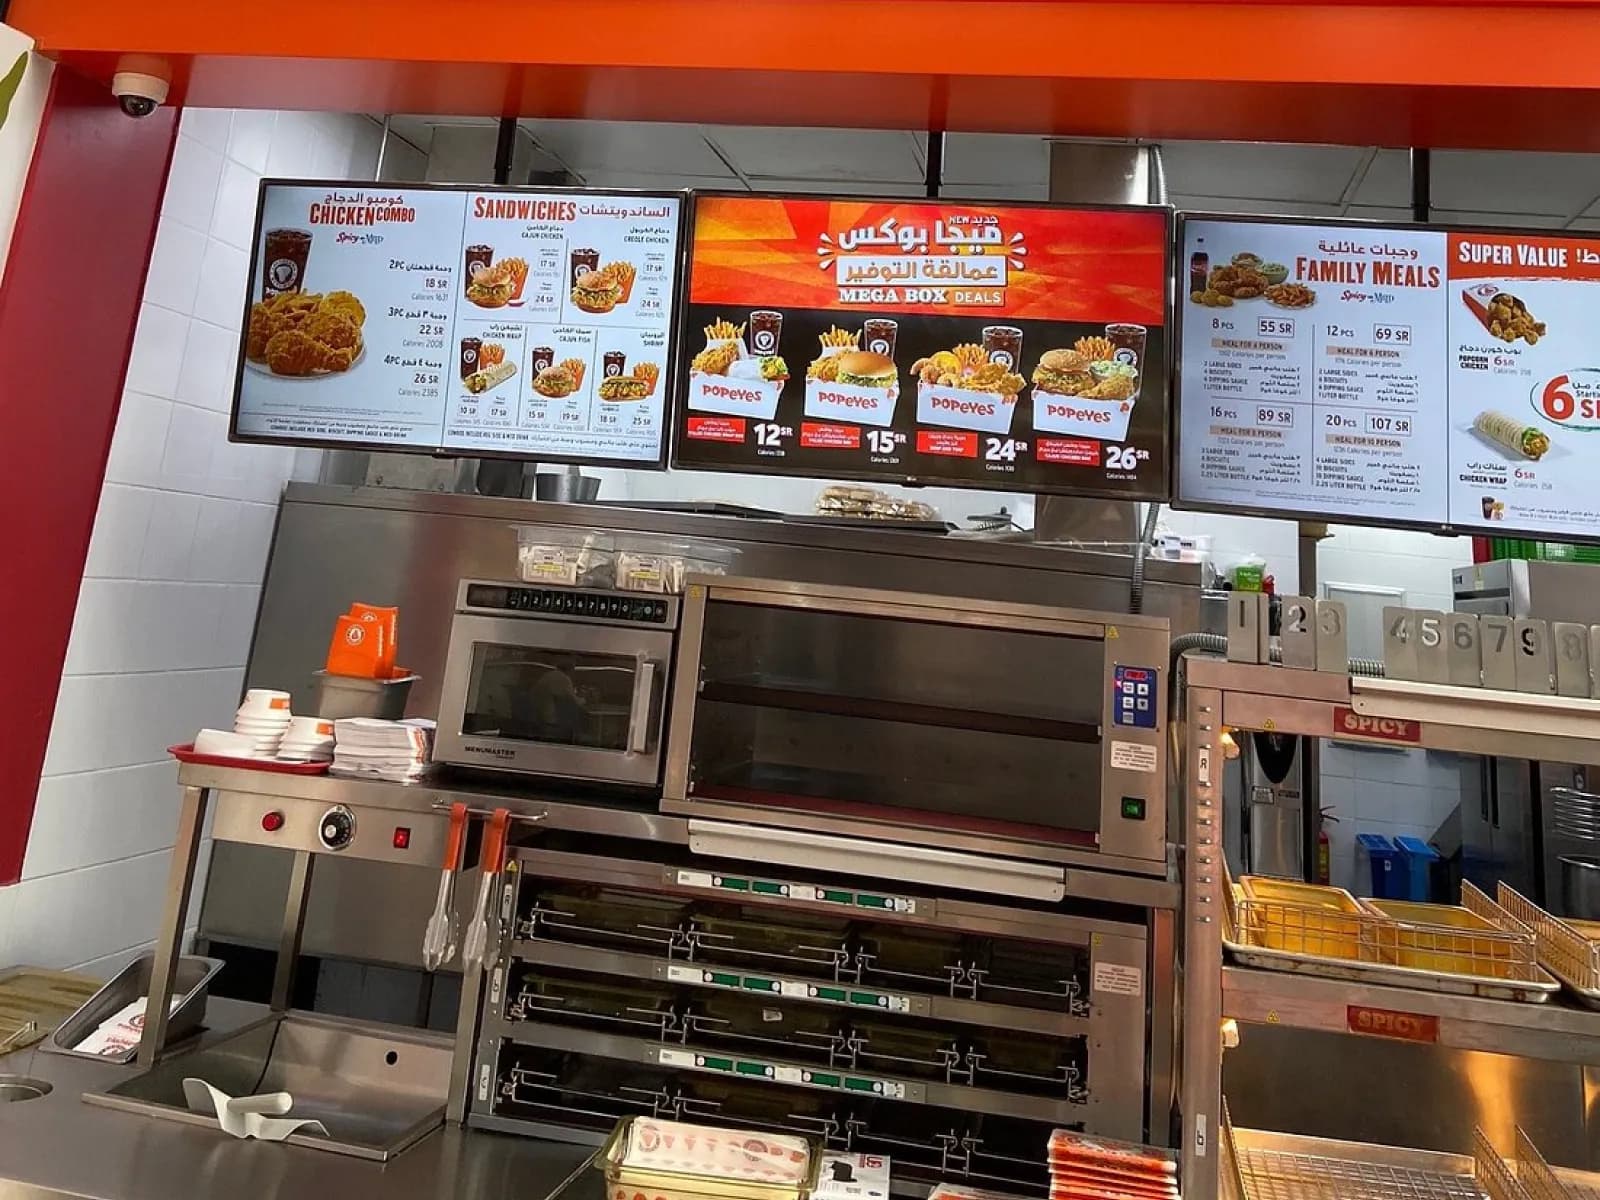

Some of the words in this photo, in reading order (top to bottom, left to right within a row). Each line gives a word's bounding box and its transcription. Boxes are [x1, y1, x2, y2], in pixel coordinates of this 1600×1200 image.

[325, 191, 363, 204] الدجاج
[366, 194, 404, 206] كومبو
[309, 203, 375, 226] CHICKEN
[376, 206, 415, 222] COMBO
[474, 196, 577, 222] SANDWICHES
[579, 203, 671, 219] الساندويتشات
[949, 215, 970, 225] NEW
[970, 215, 998, 227] جديد
[335, 231, 359, 244] Spicy
[624, 235, 644, 243] CREOLE
[646, 236, 670, 244] CHICKEN
[837, 217, 929, 255] بوكس
[1318, 240, 1366, 255] عائلية
[1369, 242, 1418, 260] وجبات
[1459, 241, 1512, 265] SUPER
[1516, 244, 1569, 268] VALUE
[389, 259, 405, 270] 2PC
[540, 260, 548, 268] 17
[646, 264, 653, 272] 17
[654, 264, 663, 272] SR
[921, 259, 998, 280] عمالقة
[845, 261, 917, 282] التوفير
[1296, 256, 1367, 285] FAMILY
[1372, 260, 1441, 288] MEALS
[425, 278, 436, 288] 18
[437, 280, 448, 289] SR
[535, 295, 545, 303] 24
[545, 296, 554, 304] SR
[839, 288, 899, 303] MEGA
[905, 289, 948, 303] BOX
[955, 291, 1002, 304] DEALS
[1341, 289, 1367, 302] Spicy
[641, 299, 651, 308] 24
[388, 307, 404, 317] 3PC
[419, 325, 432, 335] 22
[433, 326, 445, 335] SR
[1212, 318, 1220, 329] 8
[1221, 322, 1234, 330] PCS
[1260, 320, 1276, 333] 55
[1279, 322, 1292, 334] SR
[1327, 325, 1339, 336] 12
[1340, 329, 1354, 337] PCS
[1375, 328, 1392, 340] 69
[1395, 330, 1409, 341] SR
[402, 339, 424, 348] Calories
[1337, 346, 1354, 355] MEAL
[1354, 347, 1367, 355] FOR
[1375, 349, 1400, 358] PERSON
[1458, 354, 1489, 363] POPCORN
[384, 354, 401, 365] 4PC
[1493, 355, 1502, 366] 6
[1502, 358, 1515, 367] SR
[1323, 368, 1341, 376] LARGE
[1459, 362, 1489, 371] CHICKEN
[414, 374, 426, 384] 26
[428, 374, 439, 384] SR
[398, 387, 420, 396] Calories
[1543, 374, 1575, 420] 6
[490, 408, 498, 416] 17
[528, 411, 535, 419] 15
[537, 411, 545, 419] SR
[1210, 405, 1222, 417] 16
[1224, 410, 1237, 419] PCS
[1581, 398, 1600, 419] S
[1258, 408, 1275, 422] 89
[1278, 412, 1291, 424] SR
[1326, 414, 1341, 426] 20
[1343, 419, 1357, 428] PCS
[1371, 417, 1391, 431] 107
[1395, 420, 1409, 432] SR
[754, 423, 780, 446] 12
[780, 427, 793, 437] SR
[866, 430, 894, 454] 15
[894, 433, 907, 444] SR
[1335, 436, 1352, 444] MEAL
[1353, 437, 1366, 445] FOR
[1375, 438, 1402, 448] PERSON
[985, 437, 1015, 462] 24
[1015, 441, 1028, 452] SR
[1106, 446, 1137, 470] 26
[1136, 449, 1150, 460] SR
[1323, 465, 1348, 473] BISCUITS
[1514, 467, 1523, 479] 6
[1523, 471, 1536, 480] SR
[1214, 471, 1229, 479] LITER
[1230, 472, 1250, 481] BOTTLE
[1323, 473, 1345, 481] DIPPING
[1346, 475, 1364, 483] SAUCE
[1459, 474, 1488, 483] CHICKEN
[1488, 475, 1508, 485] WRAP
[1329, 481, 1345, 489] LITER
[1346, 482, 1367, 491] BOTTLE
[1287, 606, 1307, 633] 2
[1321, 607, 1341, 635] 3
[1390, 615, 1410, 643] 4
[1421, 619, 1441, 647] 5
[1454, 622, 1473, 650] 6
[1487, 624, 1507, 653] 7
[1522, 627, 1541, 656] 9
[1562, 632, 1581, 660] 8
[1344, 713, 1408, 736] SPICY
[464, 745, 515, 756] MENUMASTER
[1358, 1010, 1420, 1036] SPICY
